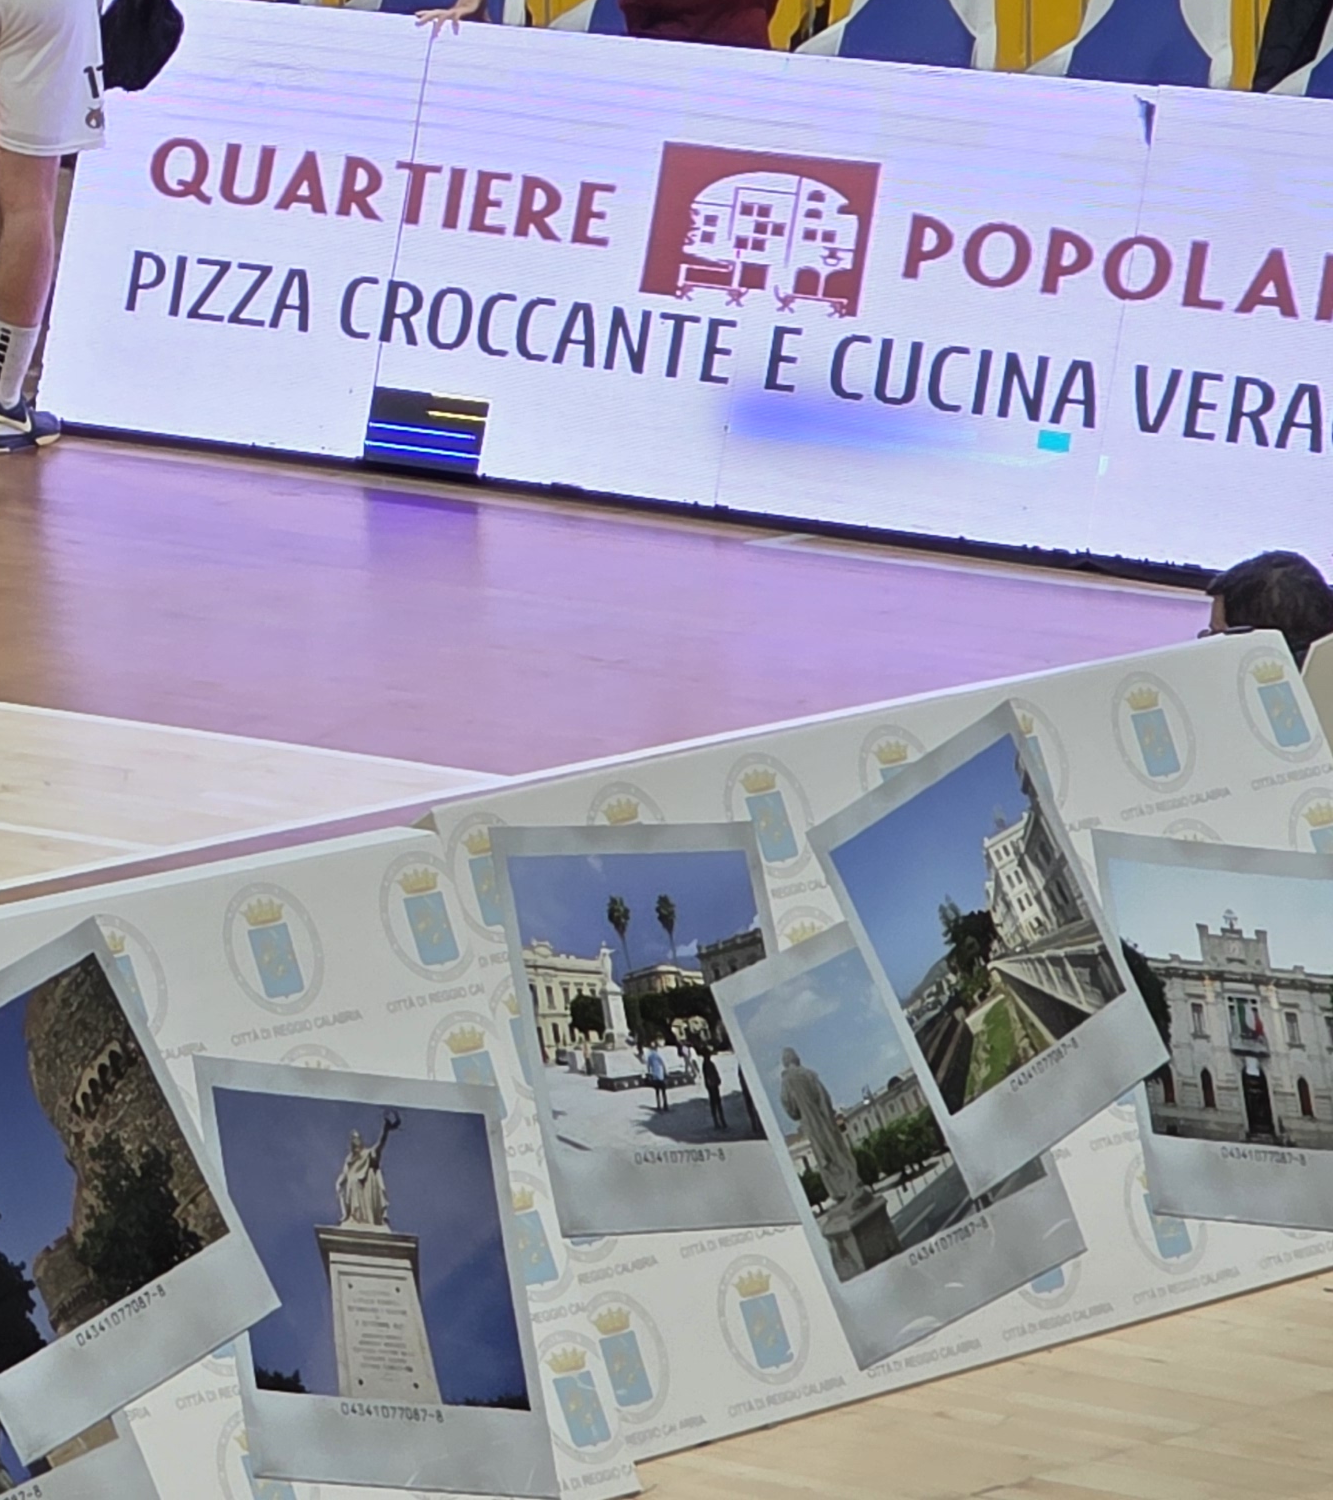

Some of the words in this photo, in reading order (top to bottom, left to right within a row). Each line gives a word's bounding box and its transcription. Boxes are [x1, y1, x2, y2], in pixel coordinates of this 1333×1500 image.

[149, 137, 616, 247] QUARTIERE
[124, 249, 312, 333] PIZZA
[340, 275, 737, 386] CROCCANTE
[764, 325, 803, 394] E
[830, 334, 1097, 430] CUCINA
[1133, 364, 1324, 455] VERA
